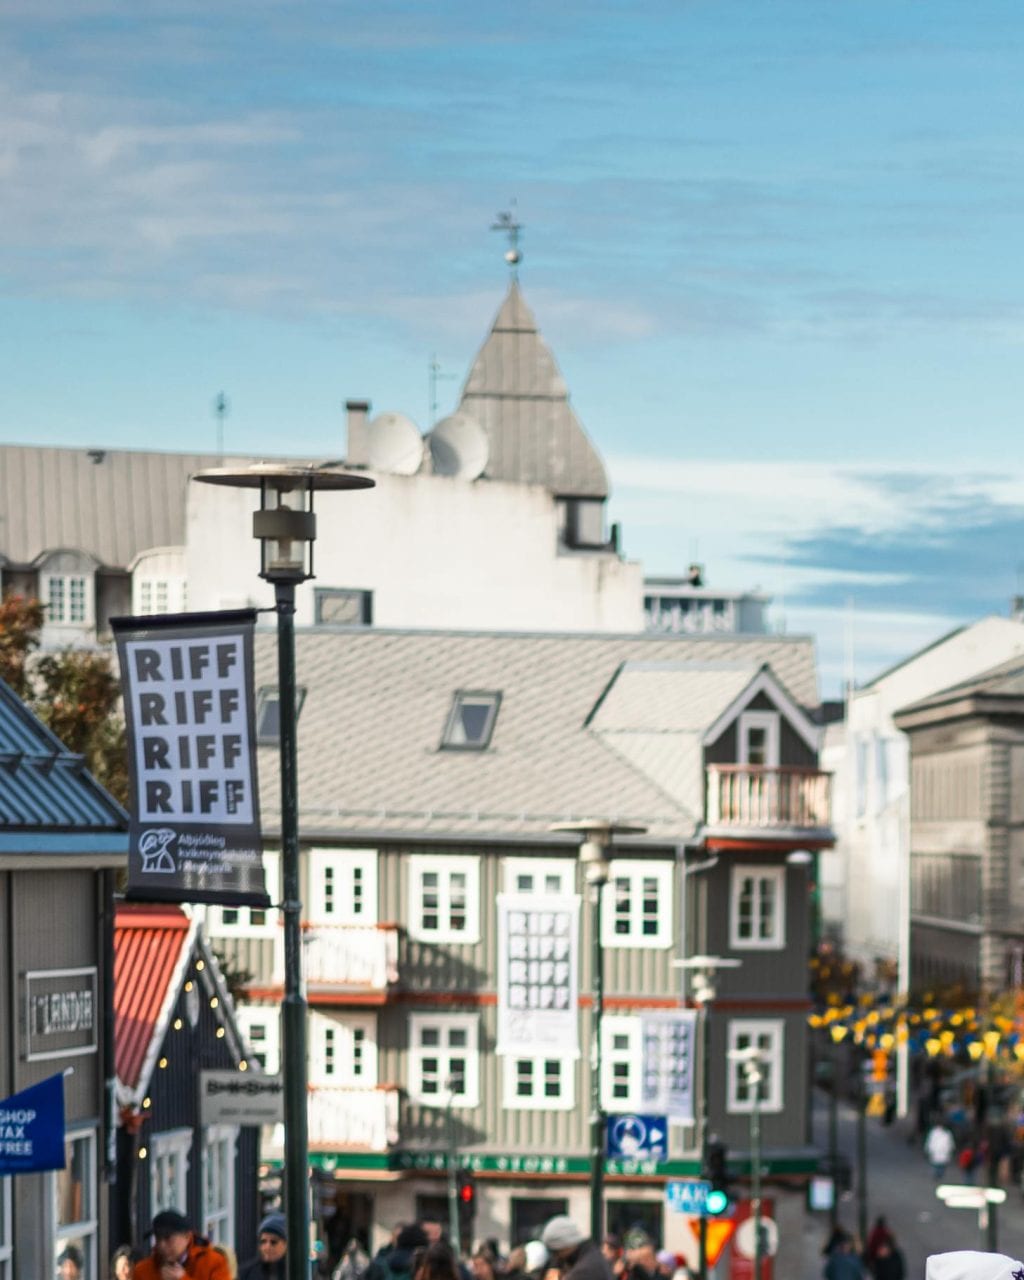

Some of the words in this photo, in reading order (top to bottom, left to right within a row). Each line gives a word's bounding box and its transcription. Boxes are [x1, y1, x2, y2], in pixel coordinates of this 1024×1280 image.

[134, 643, 237, 682] RIFF
[139, 688, 239, 726] RIFF
[143, 734, 242, 770] RIFF
[145, 779, 244, 814] RIFF
[0, 1109, 37, 1125] SHOP
[0, 1125, 25, 1139] TAX
[0, 1140, 33, 1155] FREE
